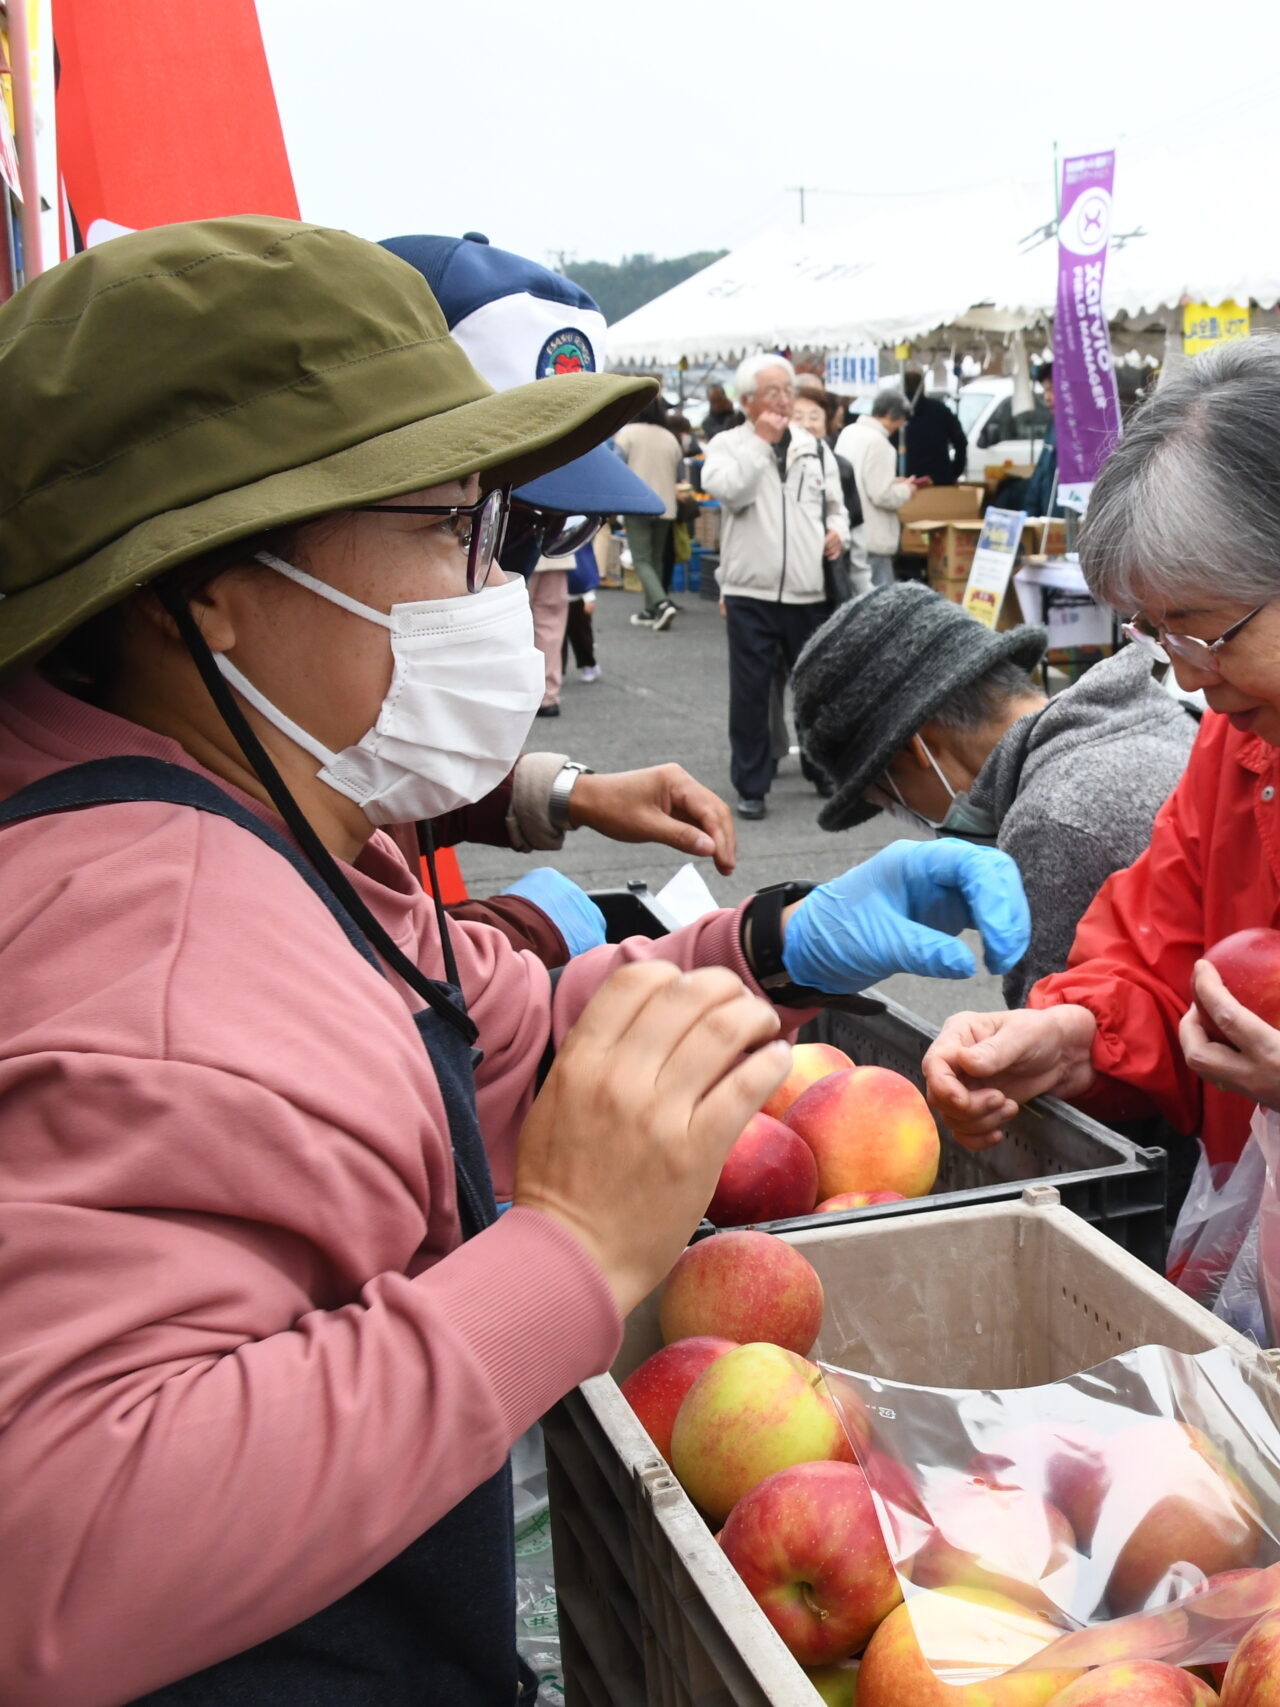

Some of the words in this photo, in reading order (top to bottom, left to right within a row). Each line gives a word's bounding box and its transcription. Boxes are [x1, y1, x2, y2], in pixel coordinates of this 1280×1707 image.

[1073, 265, 1086, 318] FIELD
[1084, 261, 1111, 372] xarvio
[1078, 320, 1107, 409] MANAGER
